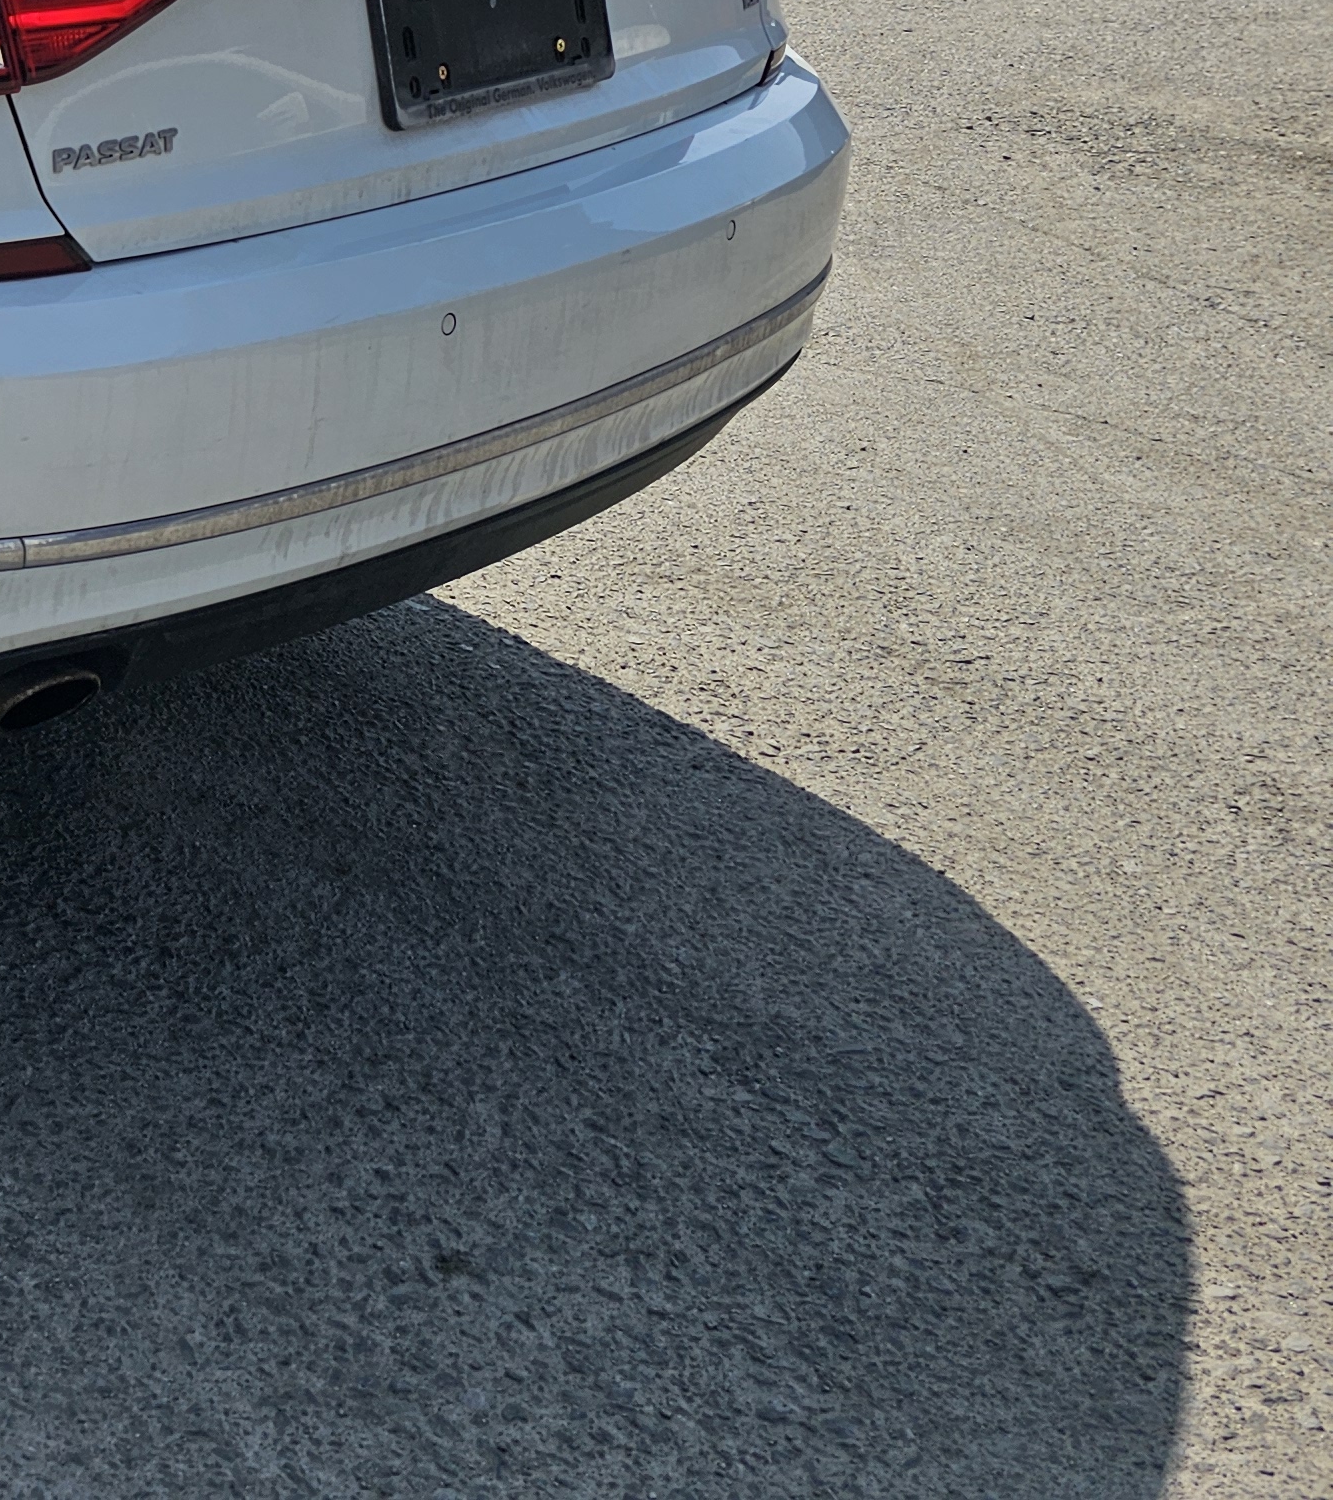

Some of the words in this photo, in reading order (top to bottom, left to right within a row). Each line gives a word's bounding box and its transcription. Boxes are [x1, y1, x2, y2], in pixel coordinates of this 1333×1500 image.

[426, 103, 447, 119] The
[448, 91, 491, 115] Original
[51, 127, 179, 174] PASSAT
